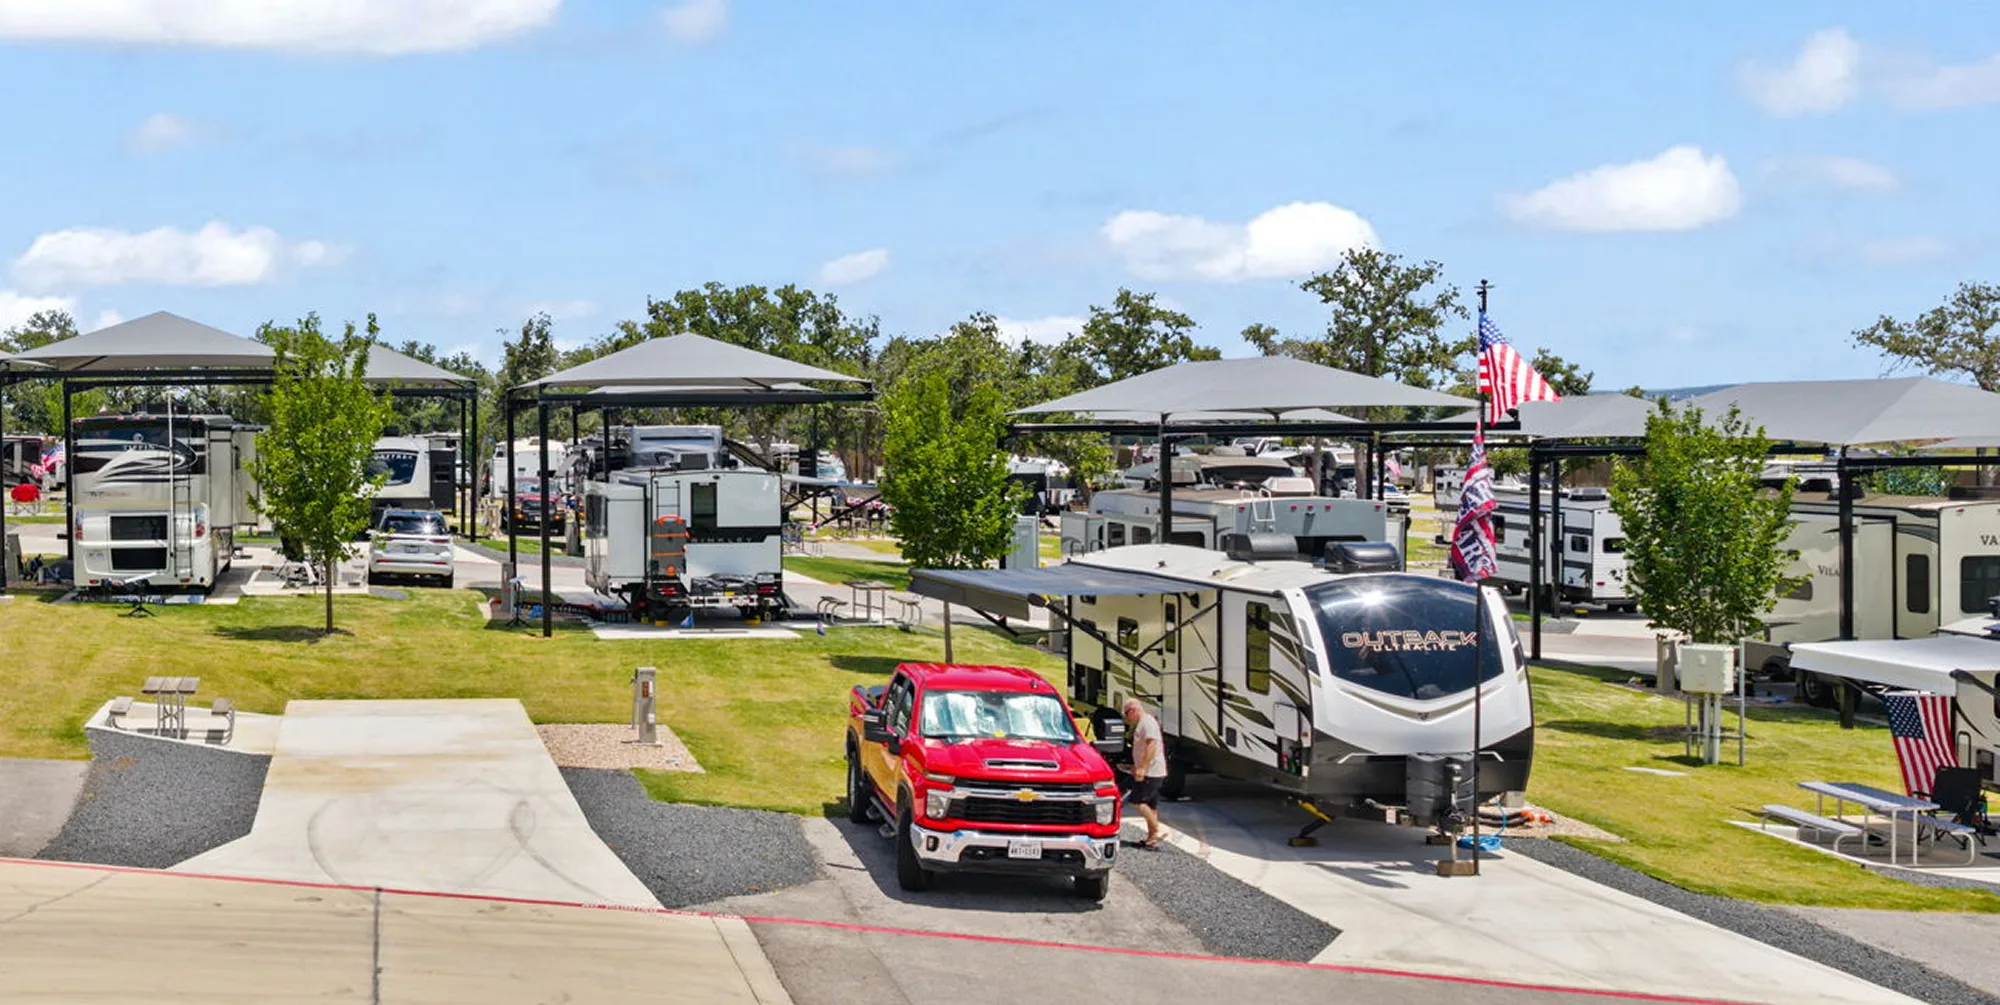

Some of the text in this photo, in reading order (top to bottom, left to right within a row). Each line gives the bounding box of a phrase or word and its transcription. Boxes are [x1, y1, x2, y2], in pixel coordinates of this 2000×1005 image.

[1980, 535, 2000, 545] VA
[1818, 565, 1840, 576] VILA
[1342, 630, 1477, 648] OUTBACK
[1373, 643, 1457, 651] ULTRALITE
